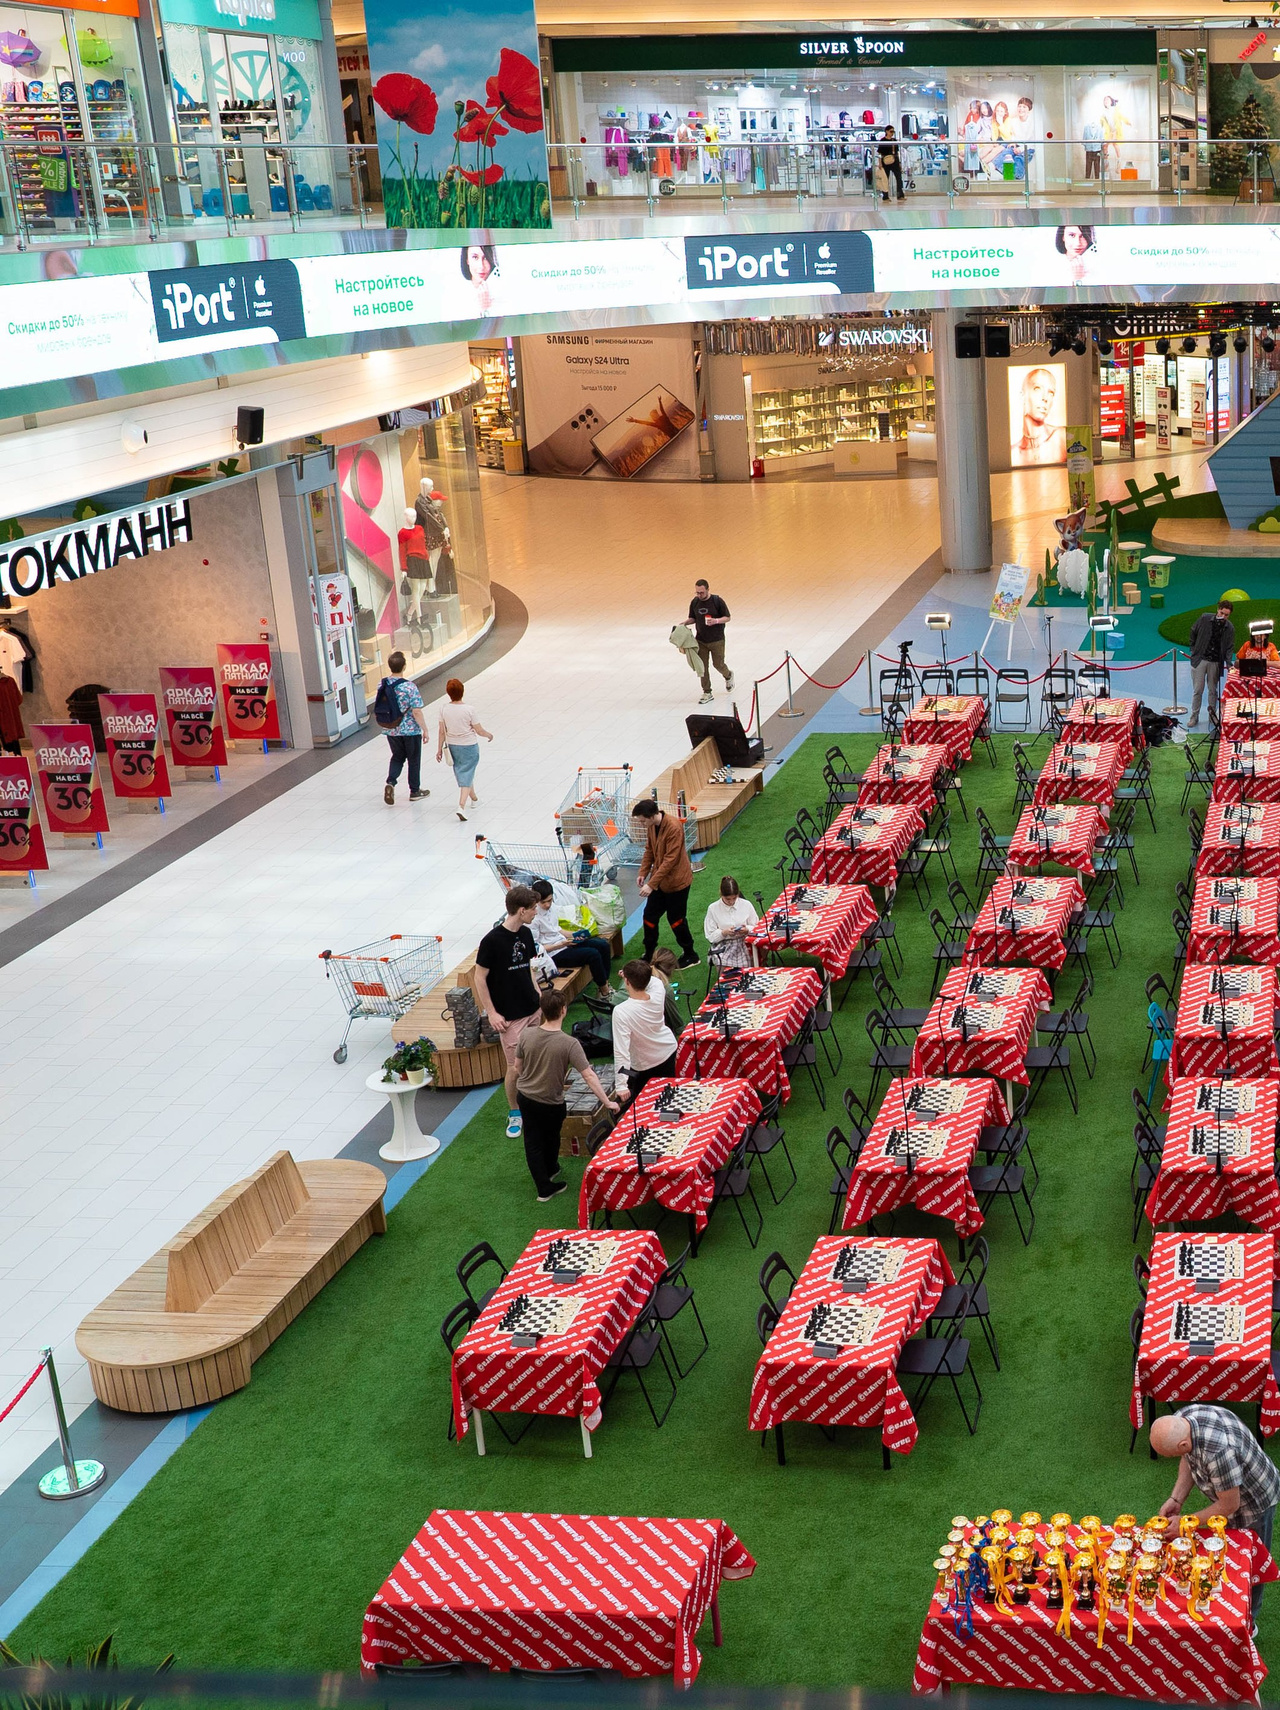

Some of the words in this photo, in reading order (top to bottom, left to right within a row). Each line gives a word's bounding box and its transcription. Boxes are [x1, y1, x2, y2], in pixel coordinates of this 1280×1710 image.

[800, 42, 849, 54] SILVER
[857, 41, 904, 54] SPOON
[1238, 31, 1267, 60] театр
[816, 56, 843, 65] Formal
[858, 56, 885, 65] Casual
[58, 161, 66, 190] СКИДКА
[913, 246, 1014, 261] Настройтесь
[1130, 247, 1169, 256] Скидки
[1171, 248, 1184, 256] до
[1186, 247, 1209, 256] 50%
[531, 269, 568, 279] Скидки
[570, 268, 582, 277] до
[584, 265, 606, 275] 50%
[932, 268, 950, 279] на
[953, 266, 1000, 278] новое
[335, 276, 425, 294] Настройтесь
[353, 304, 369, 317] на
[373, 299, 414, 315] новое
[7, 321, 47, 335] Скидки
[49, 320, 60, 332] до
[62, 314, 84, 329] 50%
[547, 335, 589, 345] SAMSUNG
[839, 328, 927, 346] SWAROVSKI
[566, 355, 593, 366] Galaxy
[595, 357, 608, 365] S24
[609, 356, 630, 365] Ultra
[570, 367, 600, 376] Настройся
[223, 662, 268, 673] ЯРКАЯ
[225, 672, 269, 680] ПЯТНИЦА
[166, 687, 214, 698] ЯРКАЯ
[168, 696, 214, 705] ПЯТНИЦА
[234, 699, 268, 719] 30%
[106, 714, 155, 726] ЯРКАЯ
[108, 725, 156, 734] ПЯТНИЦА
[179, 725, 214, 745] 30%
[39, 746, 91, 757] ЯРКАЯ
[41, 757, 92, 766] ПЯТНИЦА
[120, 754, 157, 776] 30%
[54, 787, 94, 810] 30%
